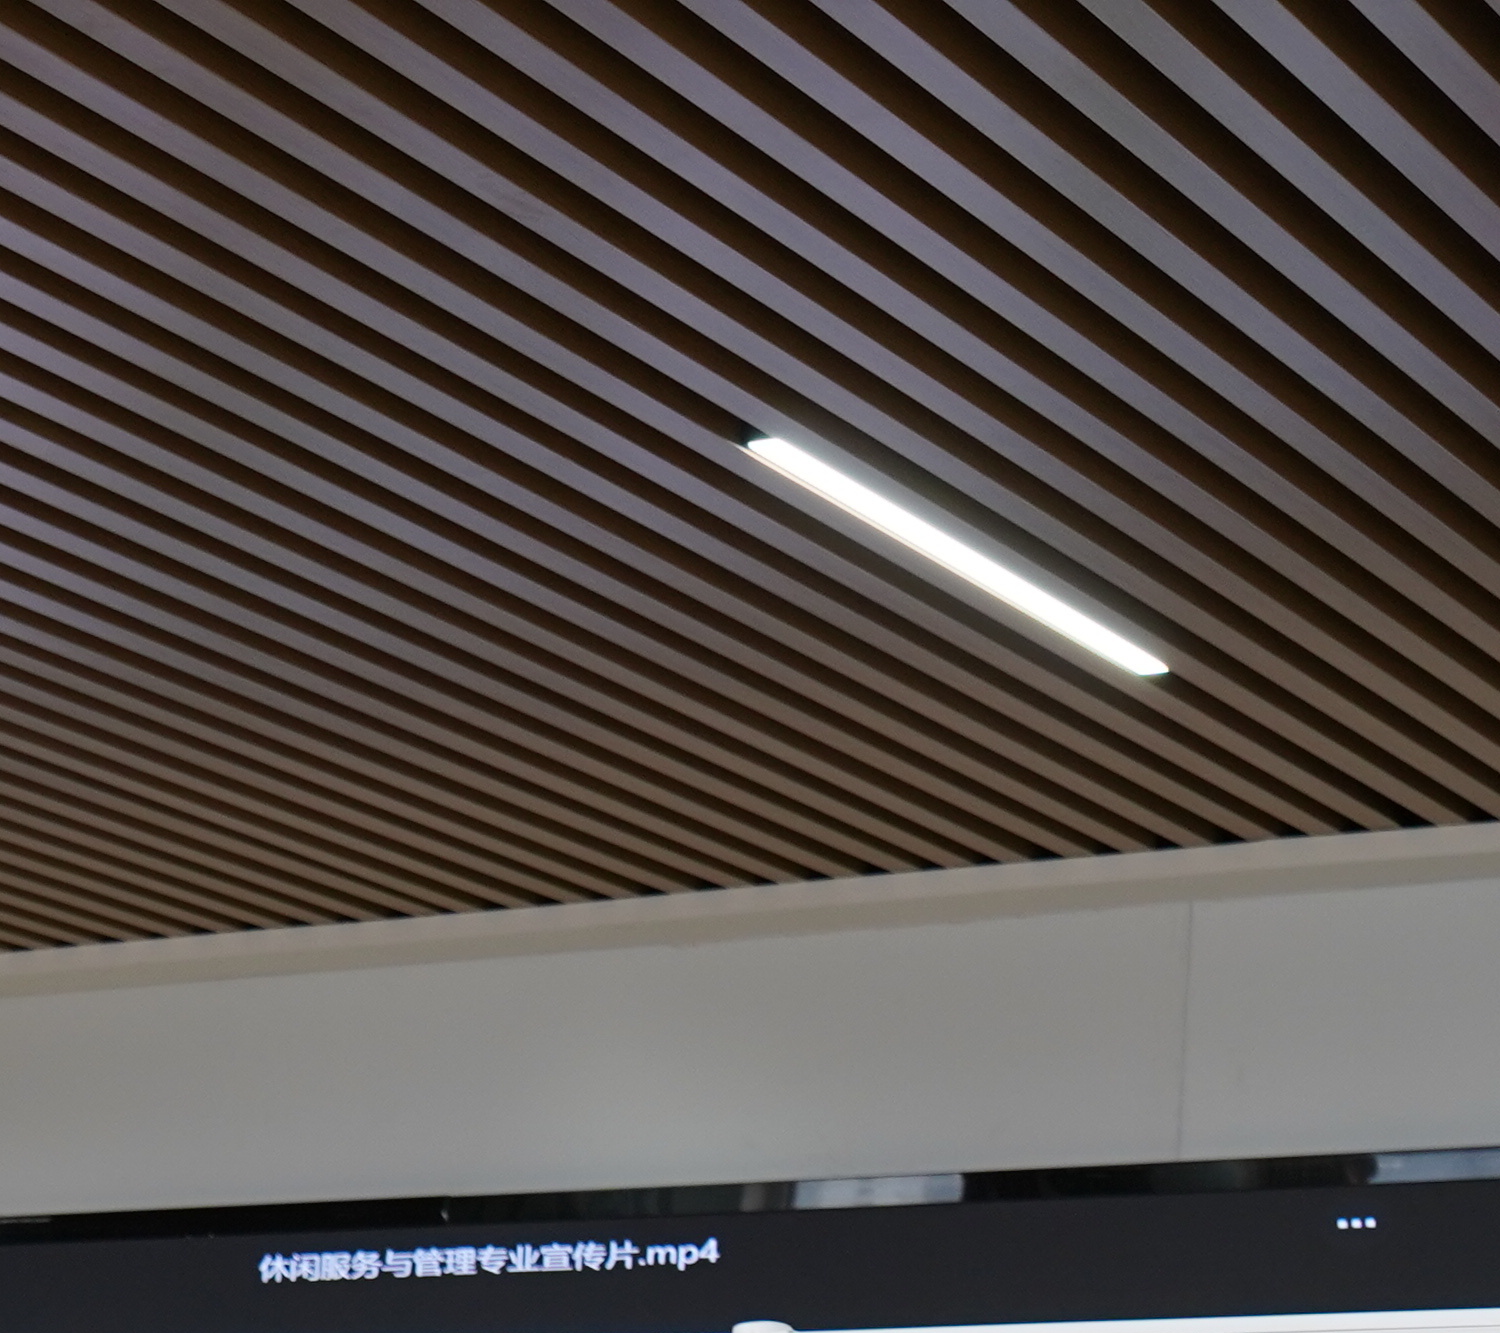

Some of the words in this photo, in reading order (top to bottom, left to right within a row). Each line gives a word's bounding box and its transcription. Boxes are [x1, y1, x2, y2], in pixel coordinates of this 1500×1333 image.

[258, 1237, 722, 1284] 休闲服务与管理专业宣传片.mp4
